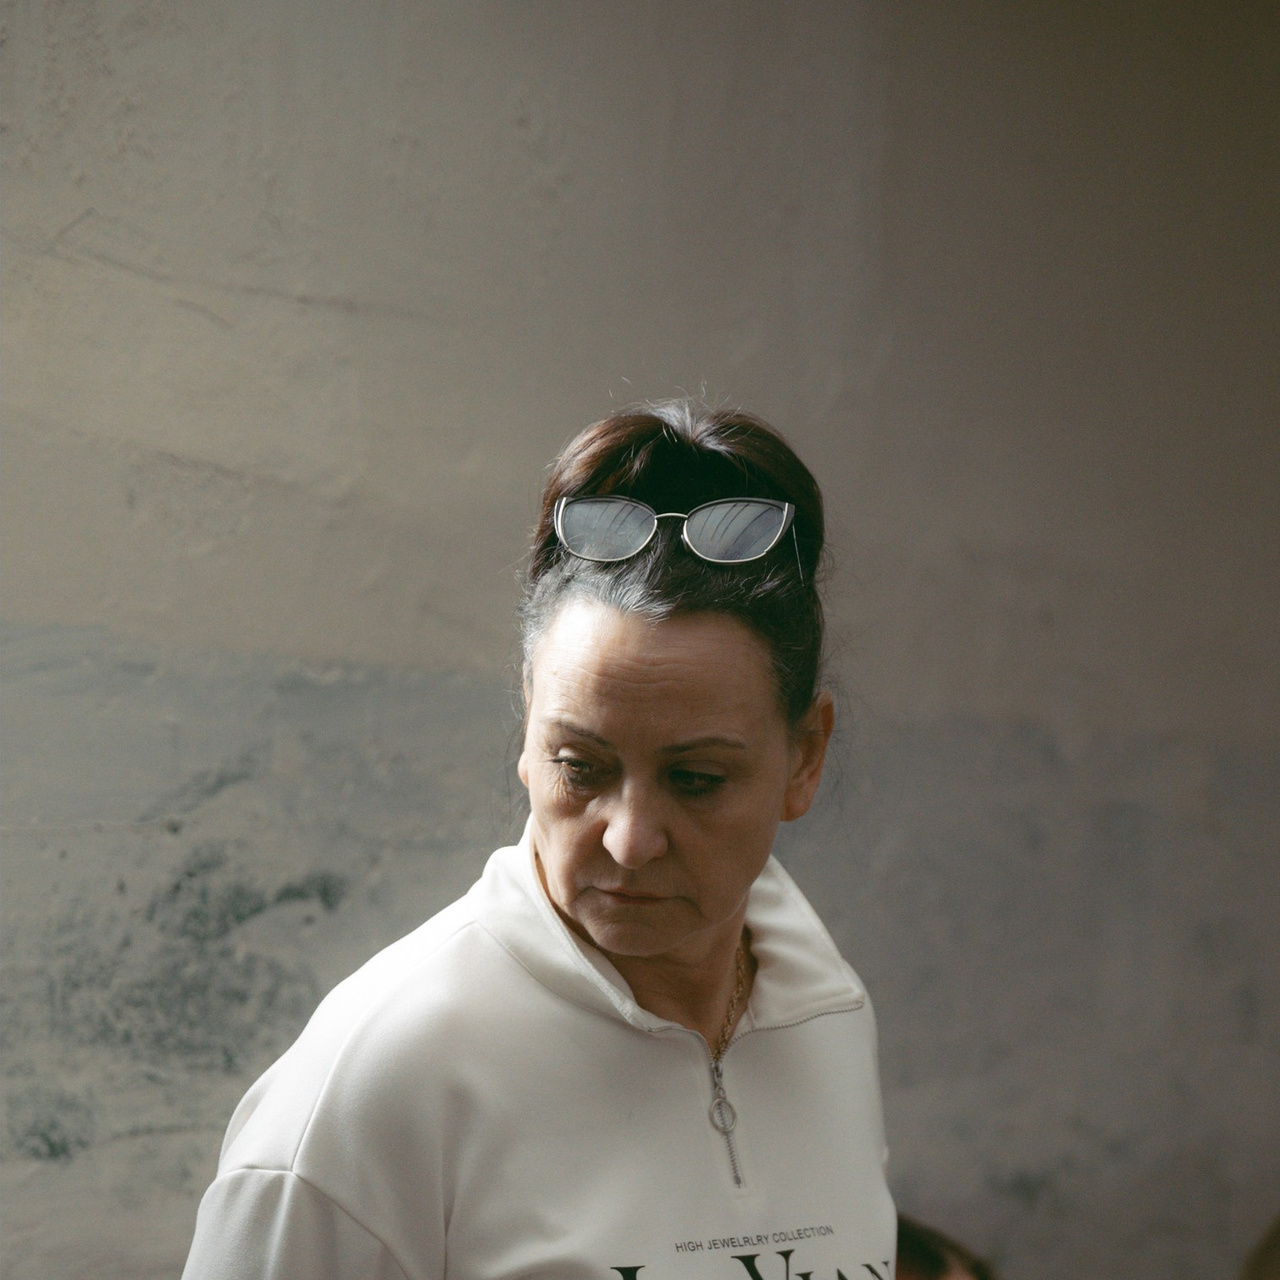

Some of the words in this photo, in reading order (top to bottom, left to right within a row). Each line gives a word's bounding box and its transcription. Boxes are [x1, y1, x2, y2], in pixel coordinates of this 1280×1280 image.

[675, 1240, 703, 1252] HIGH
[707, 1234, 770, 1250] JEWELRLRY
[772, 1225, 834, 1243] COLLECTION
